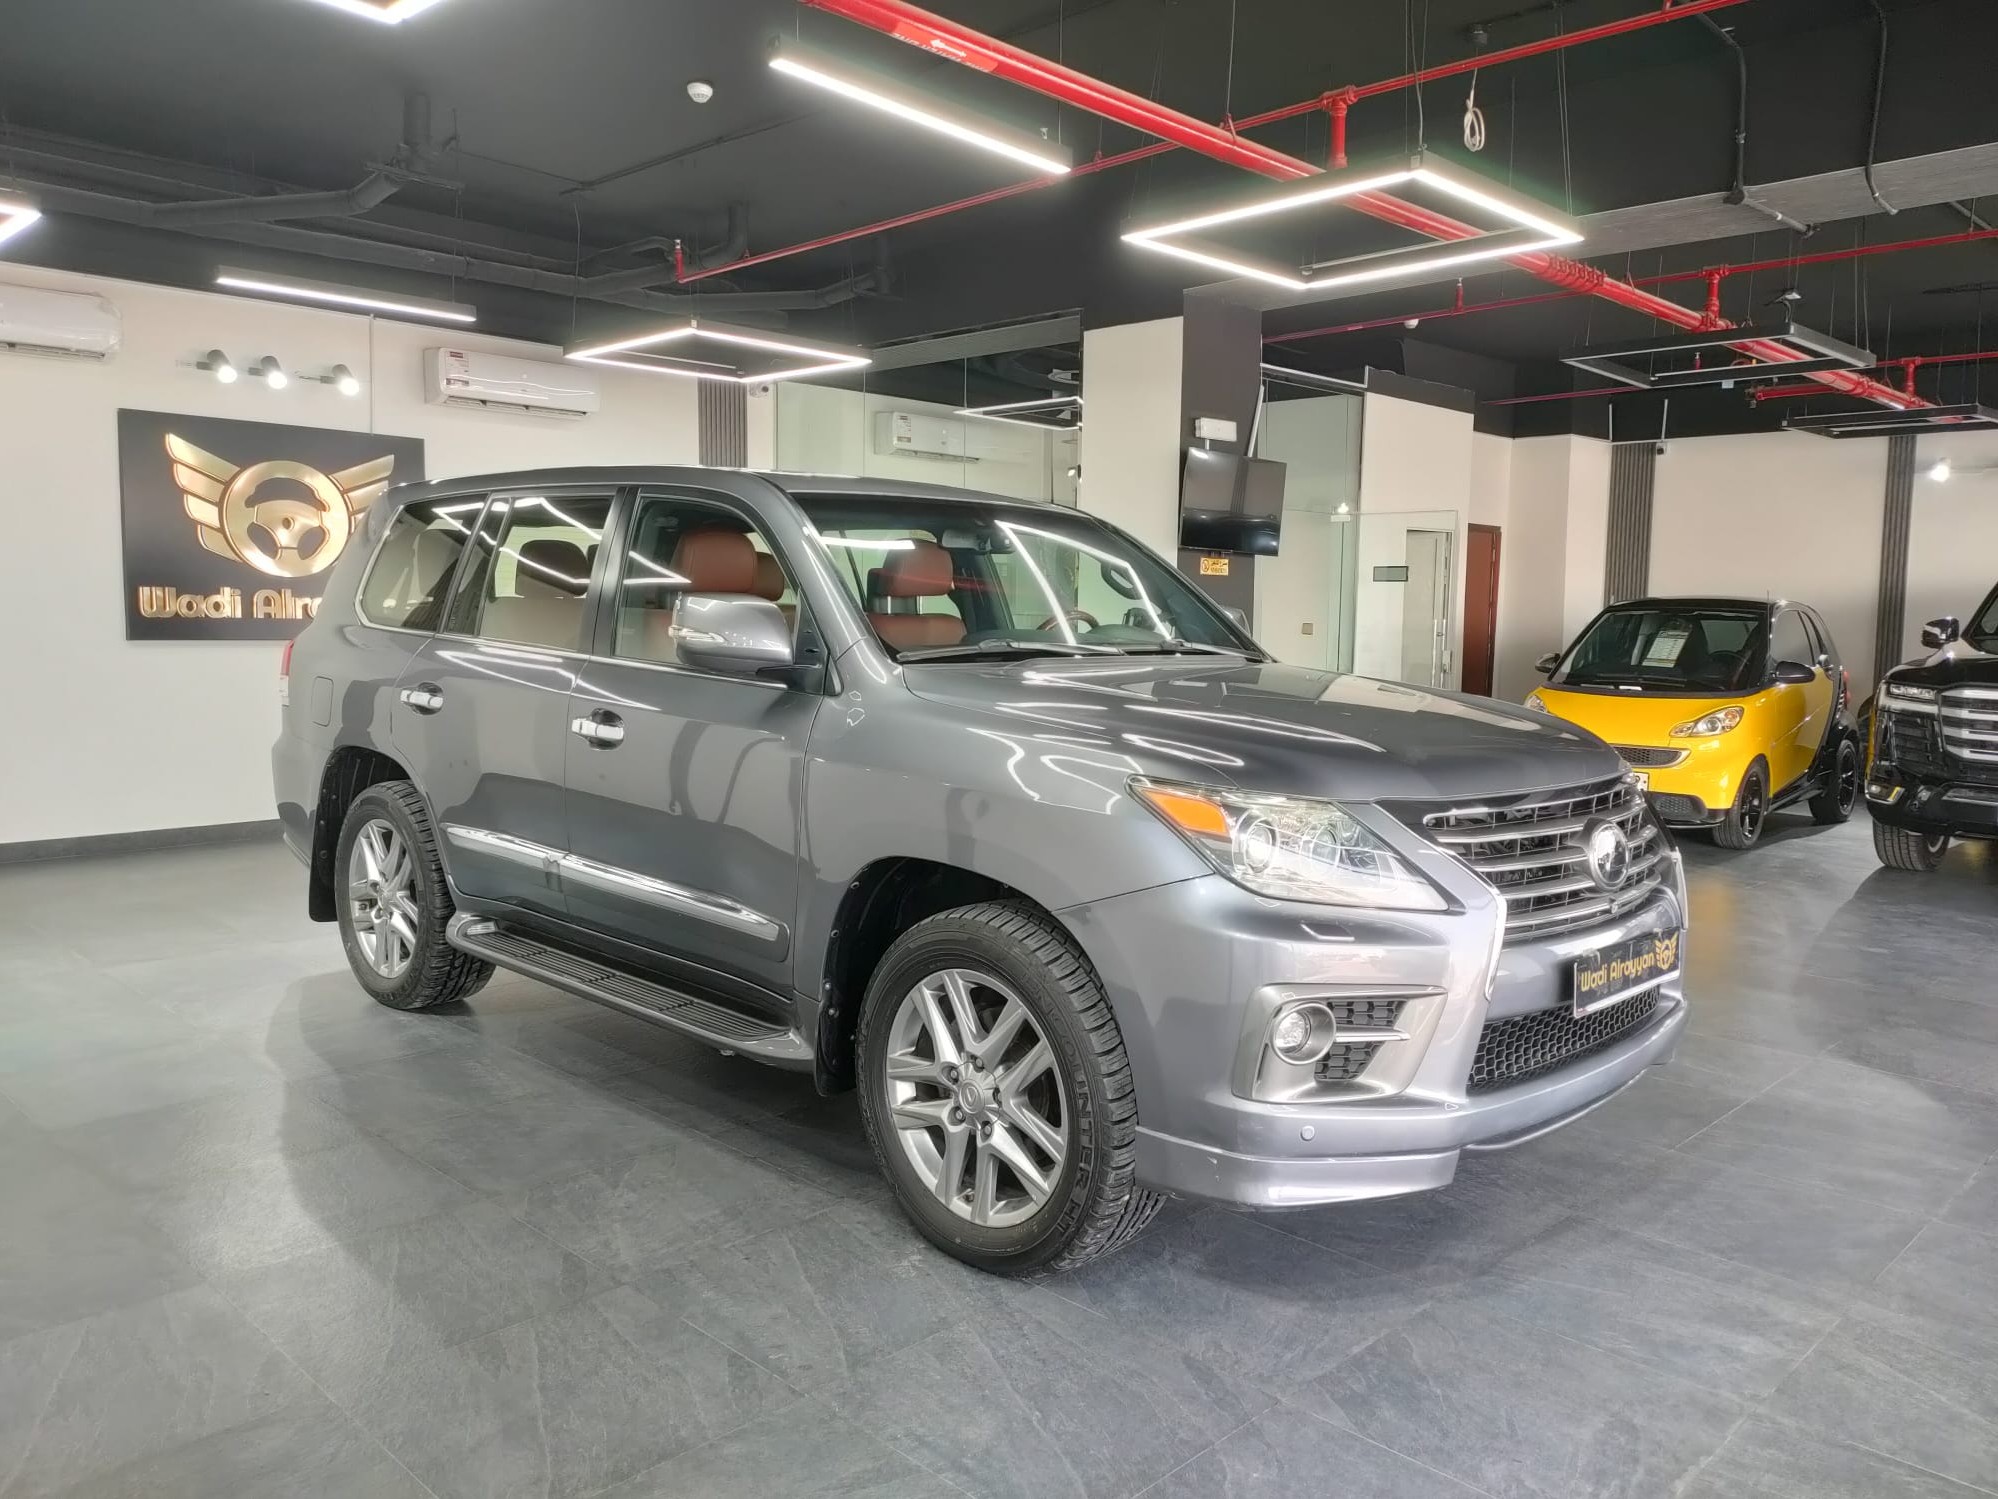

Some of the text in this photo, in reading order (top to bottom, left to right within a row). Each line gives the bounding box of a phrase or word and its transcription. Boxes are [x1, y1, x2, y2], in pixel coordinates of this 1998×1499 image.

[138, 586, 242, 619] Wadi
[1581, 952, 1655, 992] Wadi Alrayyan
